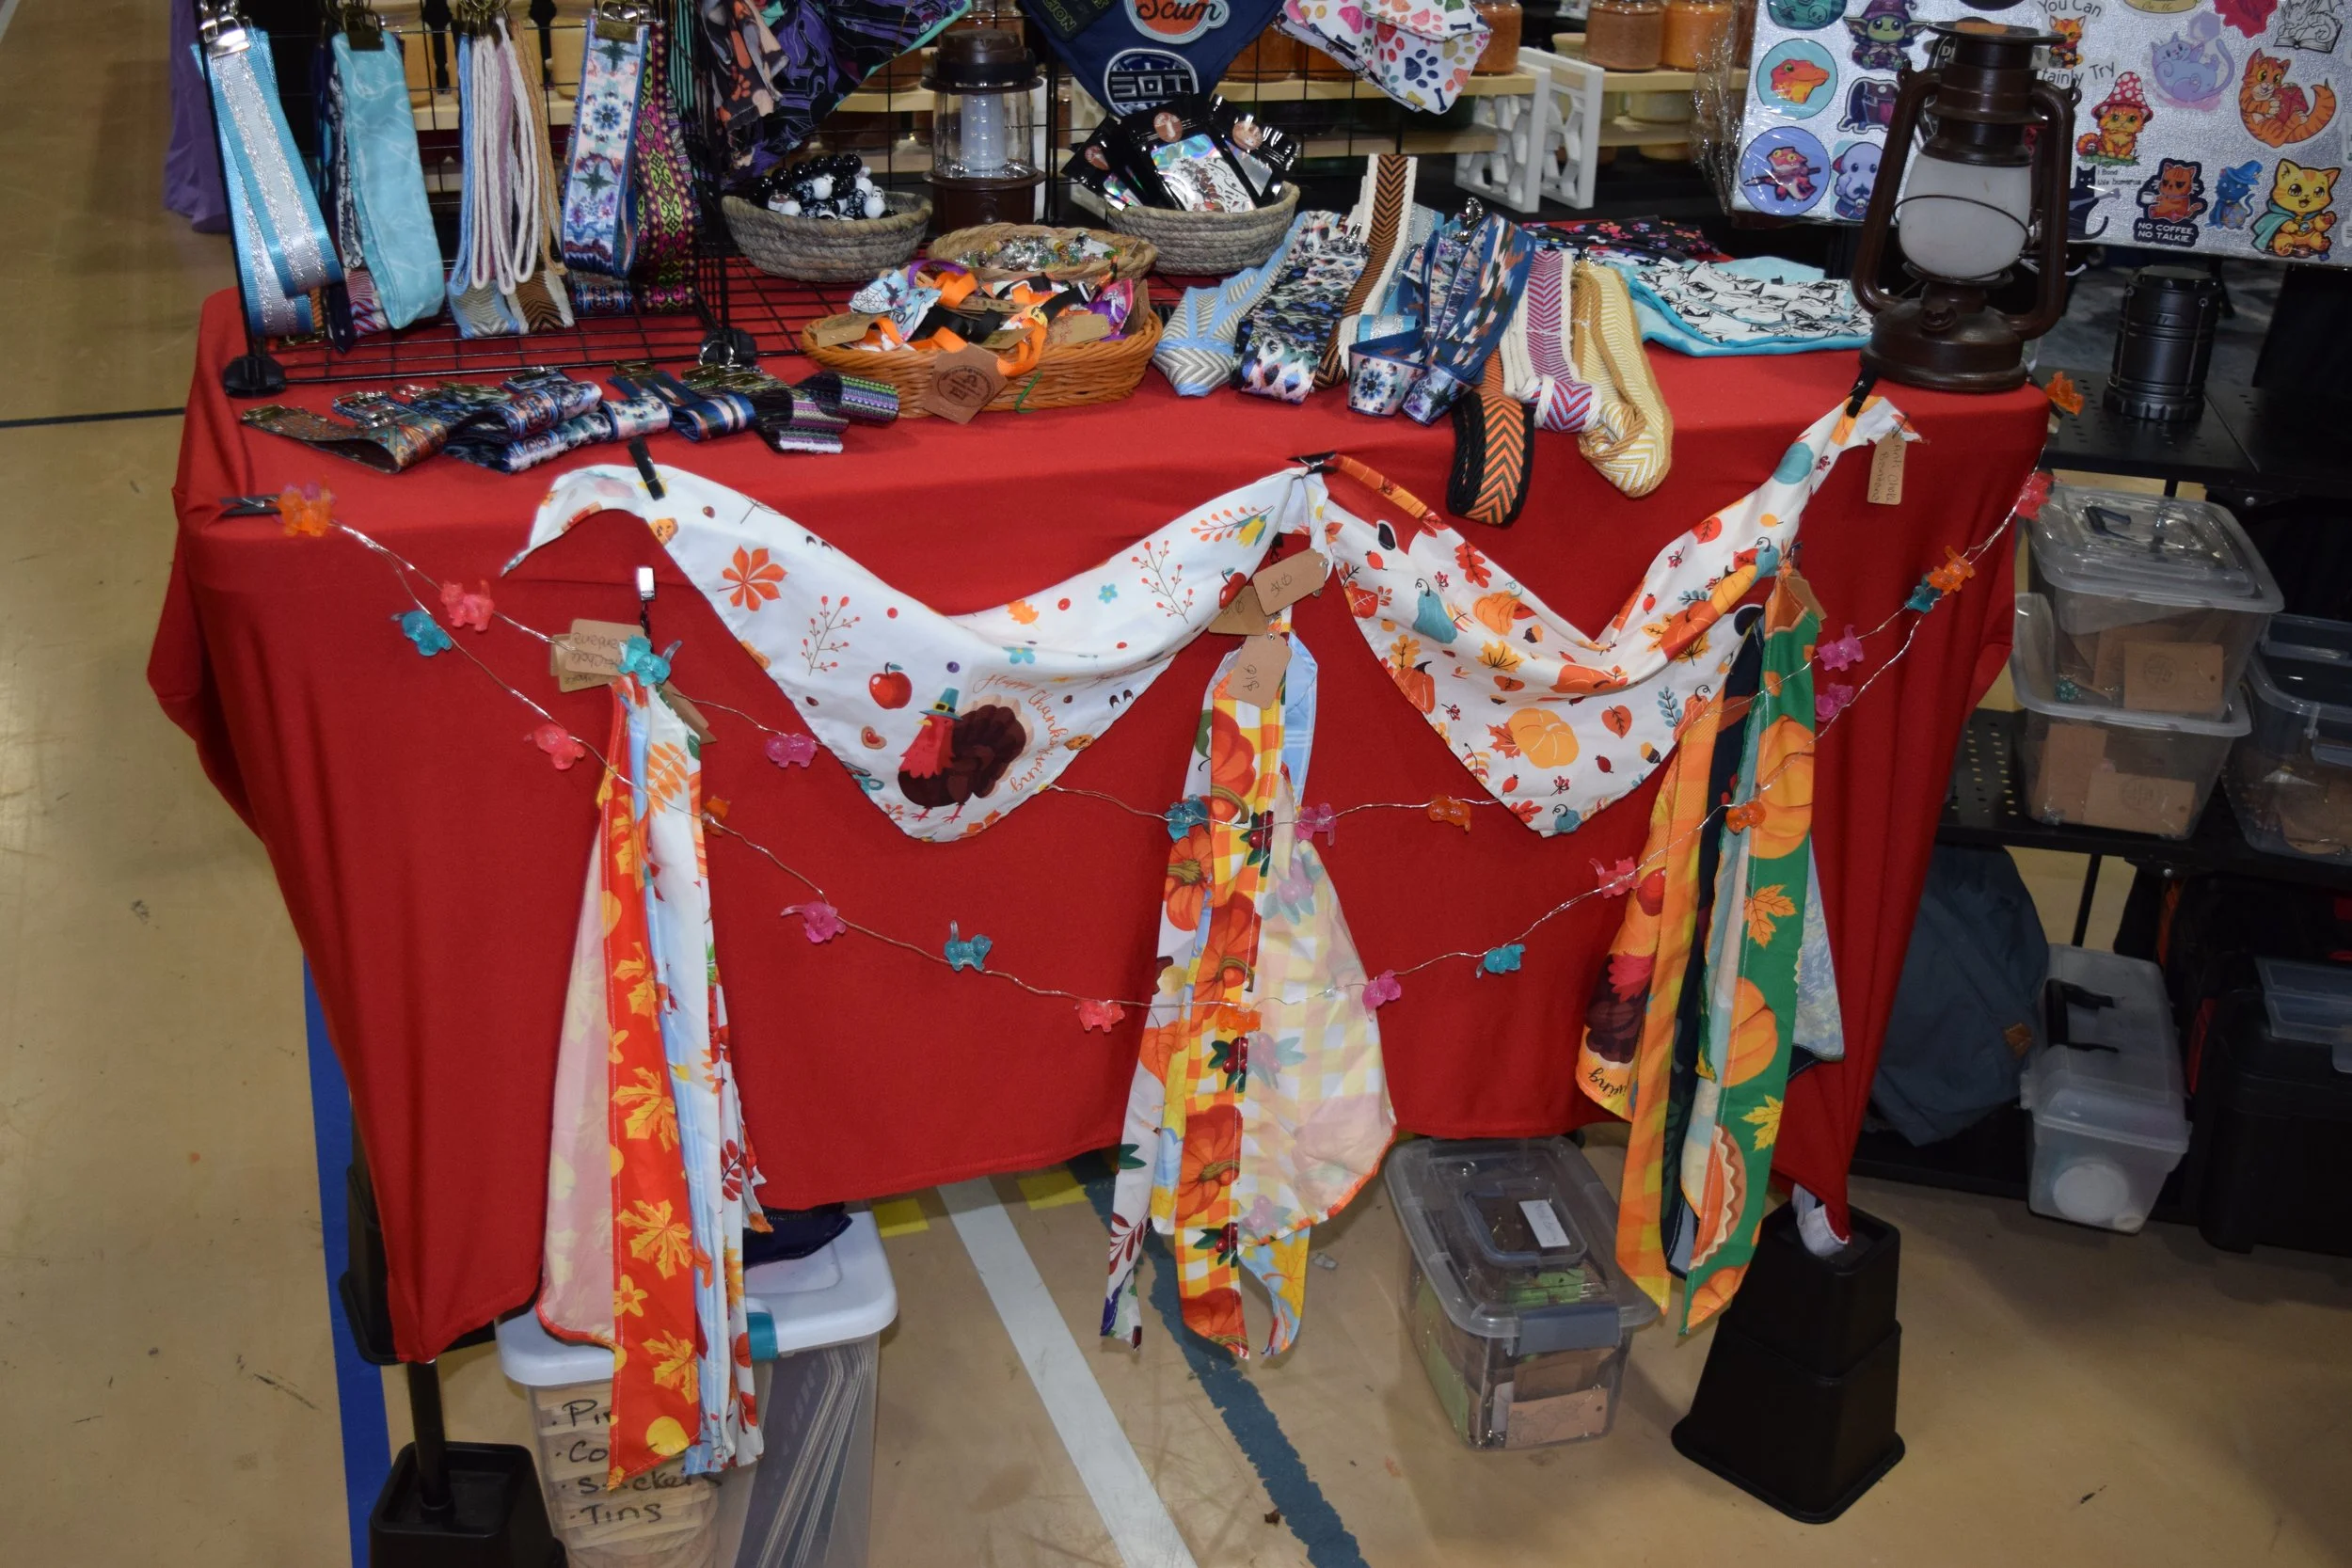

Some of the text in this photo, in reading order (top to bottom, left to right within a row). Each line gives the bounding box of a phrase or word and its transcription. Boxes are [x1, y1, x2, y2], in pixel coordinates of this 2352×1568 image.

[1136, 0, 1222, 21] Scum
[2039, 0, 2103, 17] You Can
[2042, 62, 2116, 88] tainly Try
[2137, 222, 2153, 230] NO
[572, 631, 618, 651] andana
[972, 673, 1036, 694] Happy
[568, 1440, 609, 1463] Co
[580, 1503, 662, 1526] Tins
